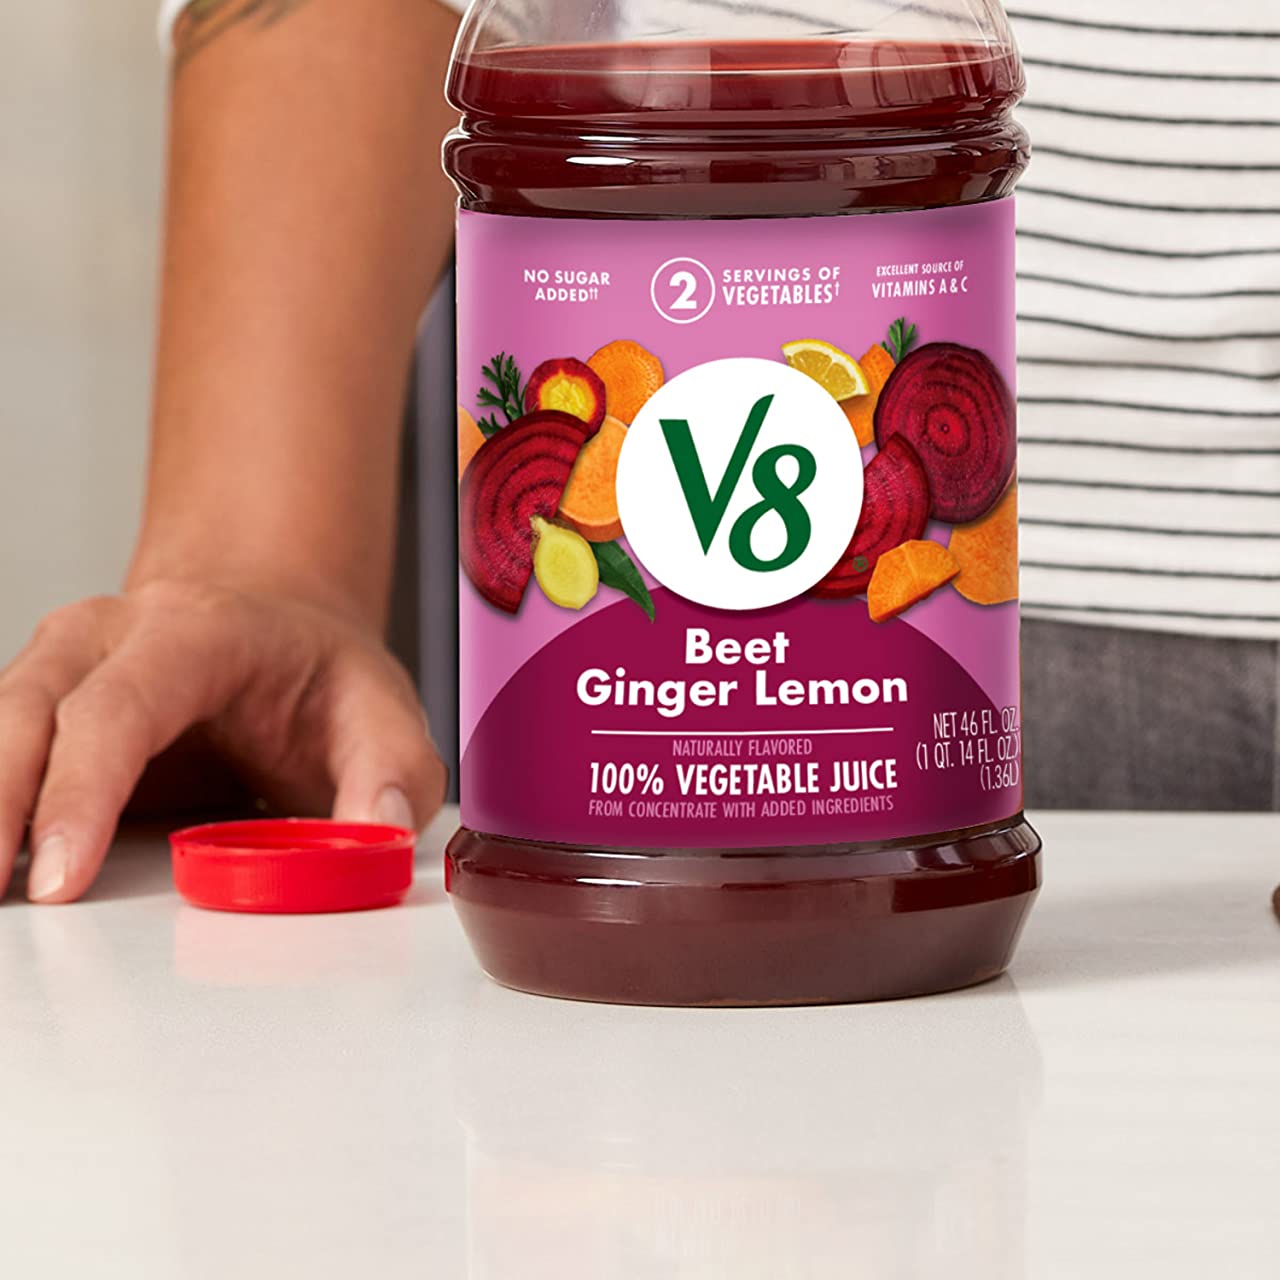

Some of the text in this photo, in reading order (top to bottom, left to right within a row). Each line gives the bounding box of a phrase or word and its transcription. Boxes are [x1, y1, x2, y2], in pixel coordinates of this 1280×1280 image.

[524, 269, 611, 285] NO SUGAR
[722, 266, 841, 283] SERVINGS OF
[876, 260, 964, 277] EXCELLENT SOURCE OF
[669, 271, 697, 310] 2
[871, 281, 936, 299] VITAMINS
[938, 280, 948, 294] A
[960, 276, 968, 293] C
[659, 394, 817, 572] V8
[685, 628, 789, 665] Beet
[576, 667, 908, 718] Ginger Lemon
[933, 711, 957, 739] NET
[960, 710, 978, 736] 46
[672, 738, 813, 757] NATURALLY FLAVORED
[916, 741, 928, 770] (1
[934, 742, 955, 769] QT.
[959, 739, 974, 766] 14
[590, 758, 898, 796] 100% VEGETABLE JUICE
[980, 760, 1019, 791] (1.36L)
[588, 795, 894, 819] FROM CONCENTRATE WITH ADDED INGREDIENTS
